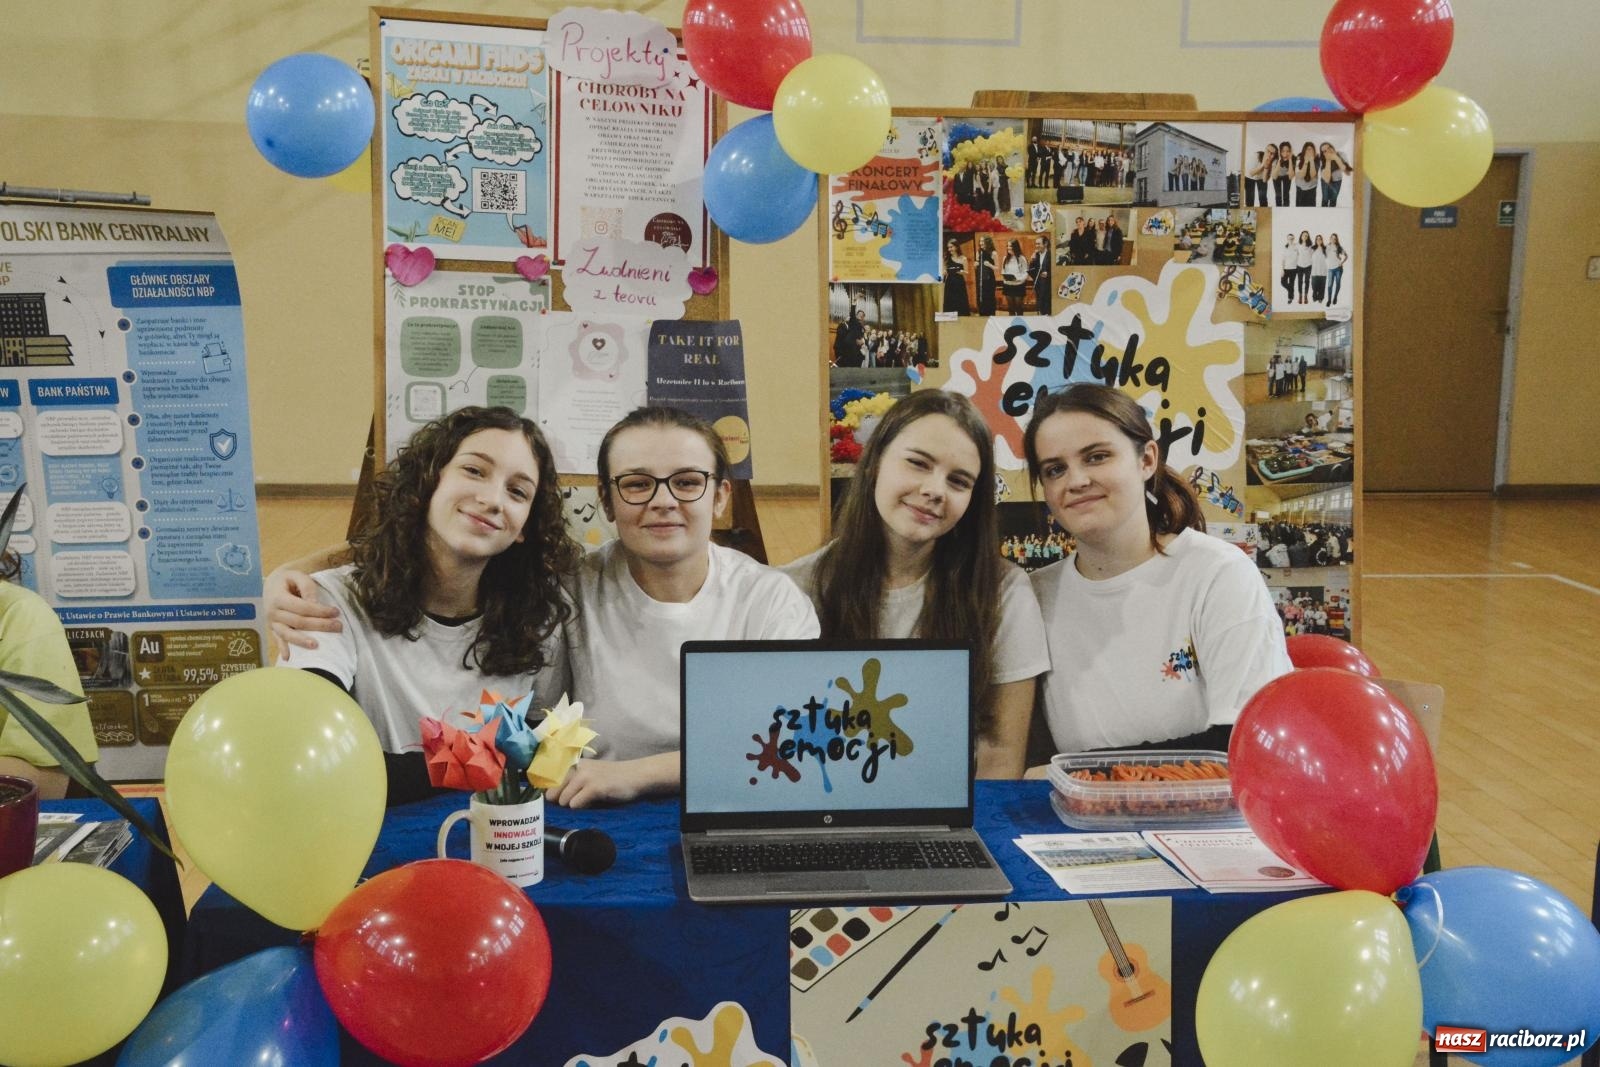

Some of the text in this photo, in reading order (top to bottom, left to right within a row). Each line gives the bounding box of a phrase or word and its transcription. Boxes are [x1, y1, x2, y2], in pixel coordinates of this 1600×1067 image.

[561, 21, 667, 82] Projekty
[577, 81, 686, 102] CHOROBY NA
[580, 97, 683, 117] CELOWNIKU
[852, 166, 920, 178] KONCERT
[849, 180, 923, 192] FINAŁOWY
[1, 222, 210, 242] OLSKI BANK CENTRALNY
[434, 223, 456, 239] ME!
[131, 273, 211, 287] GŁÓWNE OBSZARY
[133, 286, 215, 299] DZIAŁALNOŚCI NBP
[458, 284, 496, 297] STOP
[410, 296, 543, 312] PROKRASTYNACJI
[658, 334, 740, 347] TAKE IT FOR
[684, 353, 721, 365] REAL
[993, 313, 1170, 393] sztuka
[38, 384, 110, 398] BANK PAŃSTWA
[66, 610, 98, 620] Ustawie
[104, 611, 130, 620] Prawie
[132, 609, 175, 620] Bankowym
[181, 608, 210, 618] Ustawie
[218, 608, 237, 617] NBP.
[67, 630, 106, 641] LICZBACH
[139, 637, 161, 655] Au
[184, 668, 218, 683] 99,5%
[142, 694, 150, 707] 1
[769, 696, 872, 735] sztuka
[778, 732, 898, 784] emocji
[489, 813, 540, 827] WPROWADZAM
[486, 842, 493, 850] W
[494, 842, 520, 851] MOJEJ
[921, 1007, 1042, 1052] sztuka
